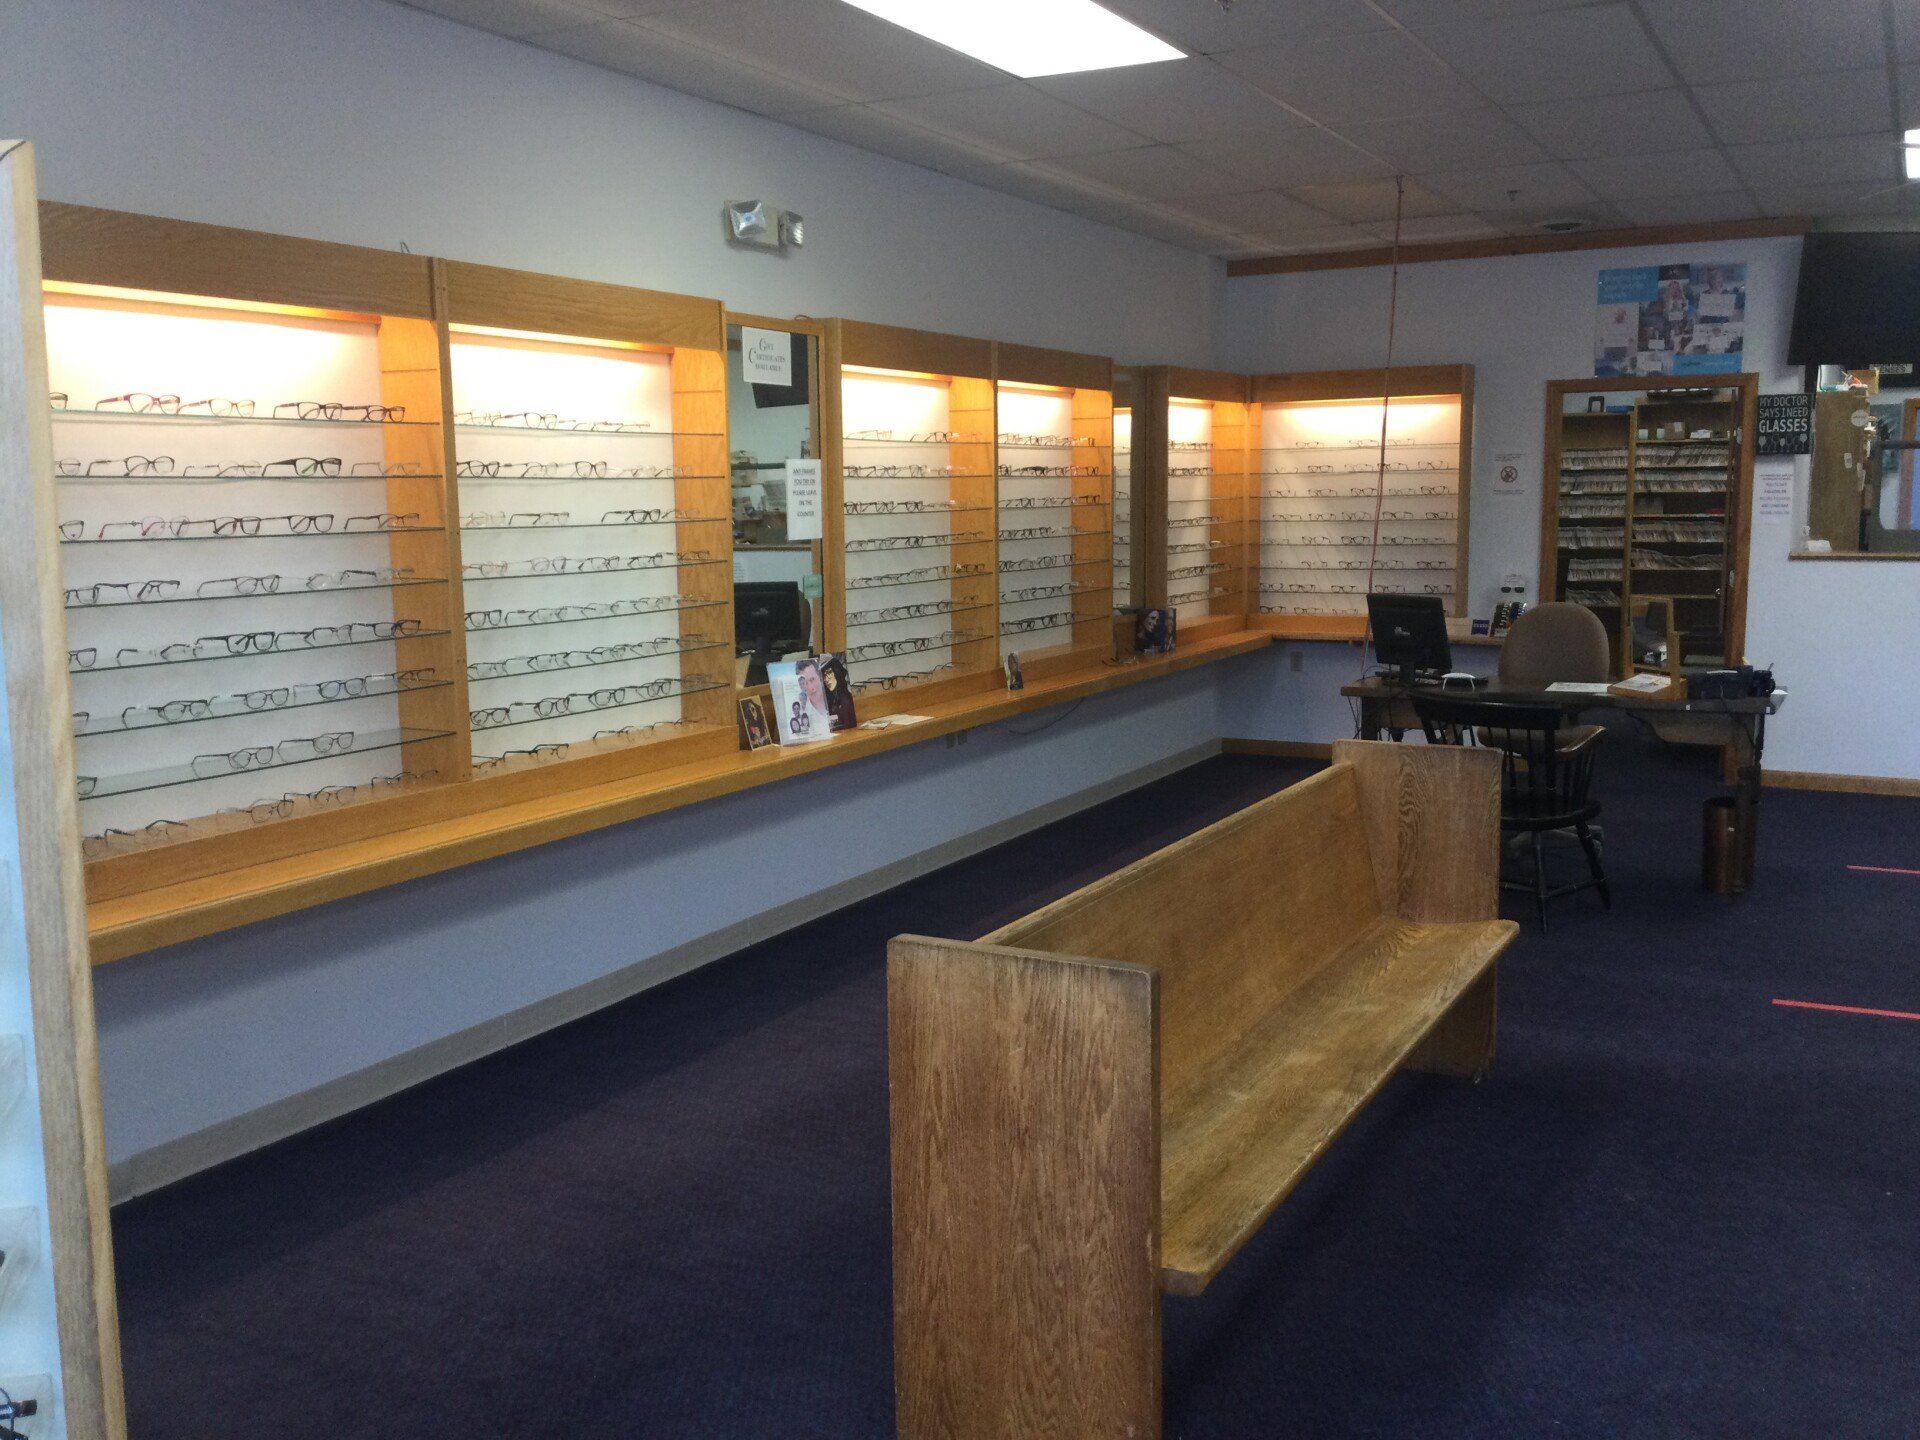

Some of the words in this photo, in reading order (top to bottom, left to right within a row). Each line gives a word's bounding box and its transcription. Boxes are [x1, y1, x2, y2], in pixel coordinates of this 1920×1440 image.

[1759, 396, 1772, 407] MY
[1773, 394, 1808, 407] DOCTOR
[1759, 407, 1780, 419] SAYS
[1786, 406, 1808, 418] NEED
[1758, 418, 1808, 434] GLASSES
